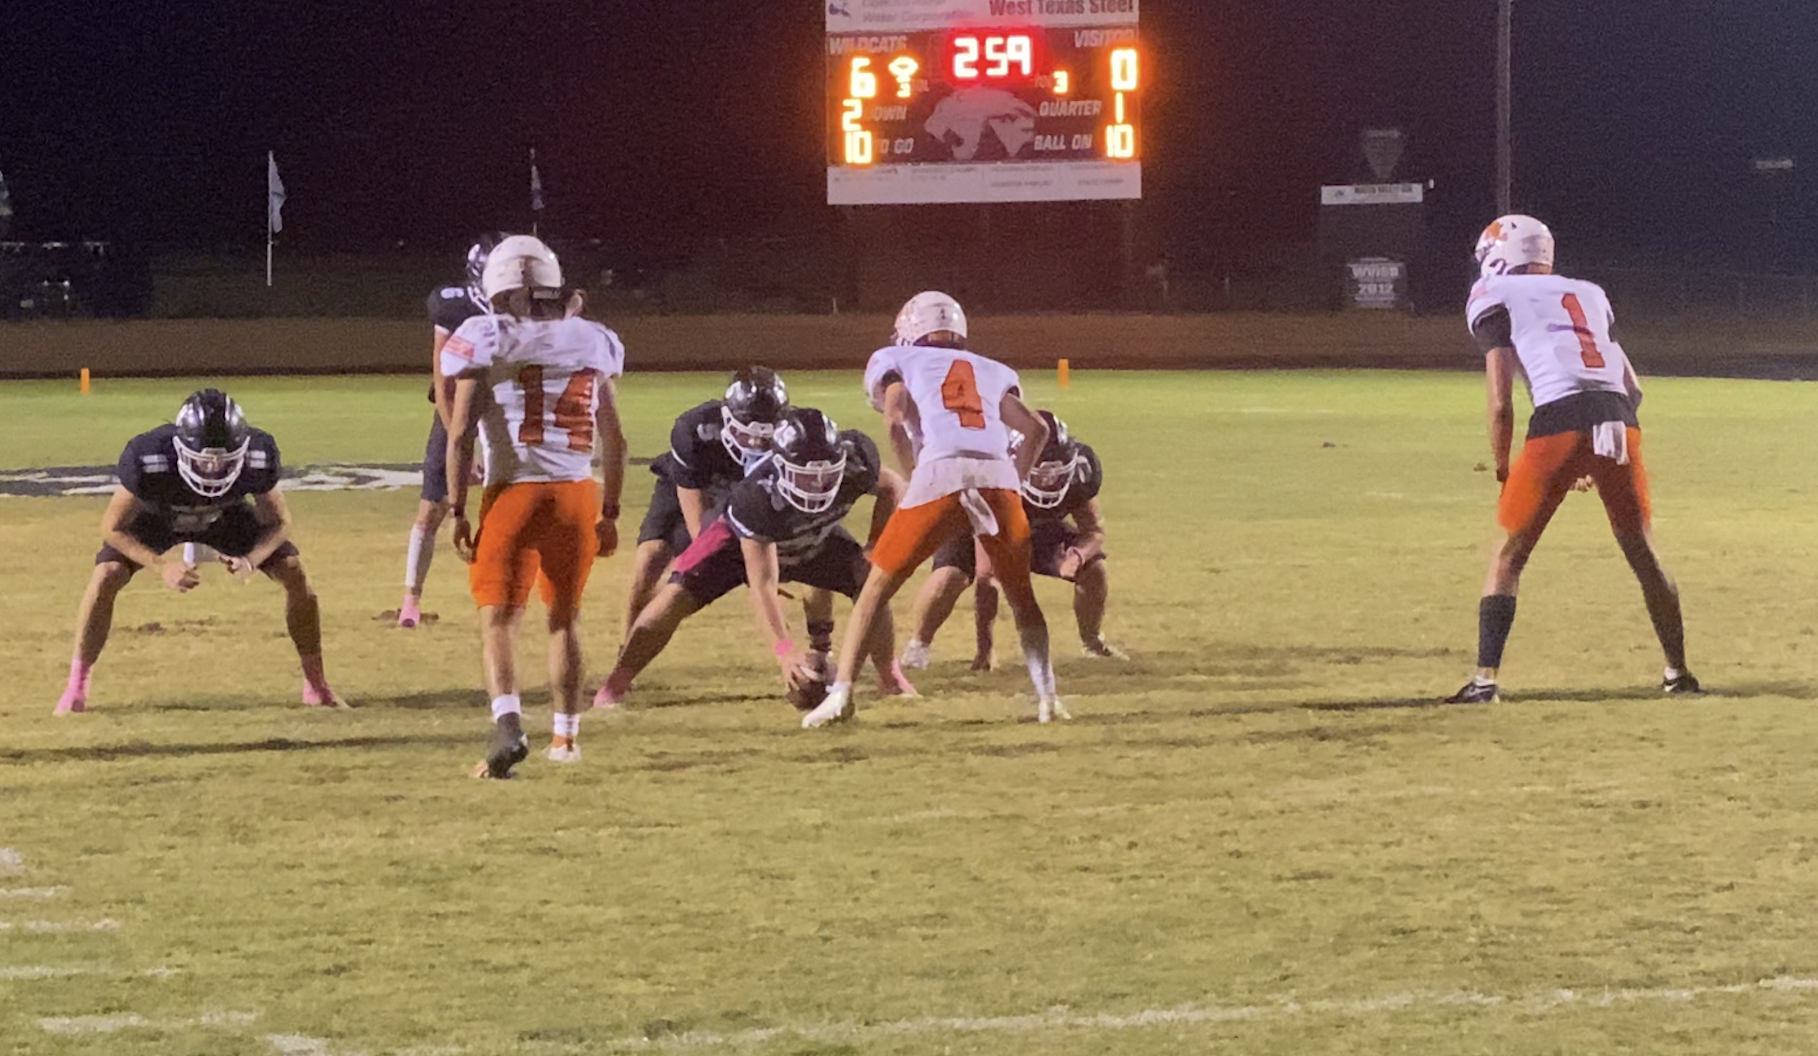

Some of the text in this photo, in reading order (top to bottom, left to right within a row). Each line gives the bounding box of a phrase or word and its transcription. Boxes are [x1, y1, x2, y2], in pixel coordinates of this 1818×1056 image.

[989, 0, 1134, 16] West Texas Steel
[850, 57, 876, 97] 6
[1053, 70, 1068, 93] 3
[1111, 49, 1137, 90] 0
[842, 98, 863, 131] 2
[868, 105, 907, 121] OWN
[1039, 99, 1102, 117] QUARTER
[845, 130, 872, 164] 10
[894, 137, 915, 154] GO
[1033, 133, 1093, 151] BALL ON
[1105, 124, 1134, 158] 10
[1560, 292, 1607, 368] 1
[518, 364, 595, 453] 14
[940, 359, 987, 430] 4
